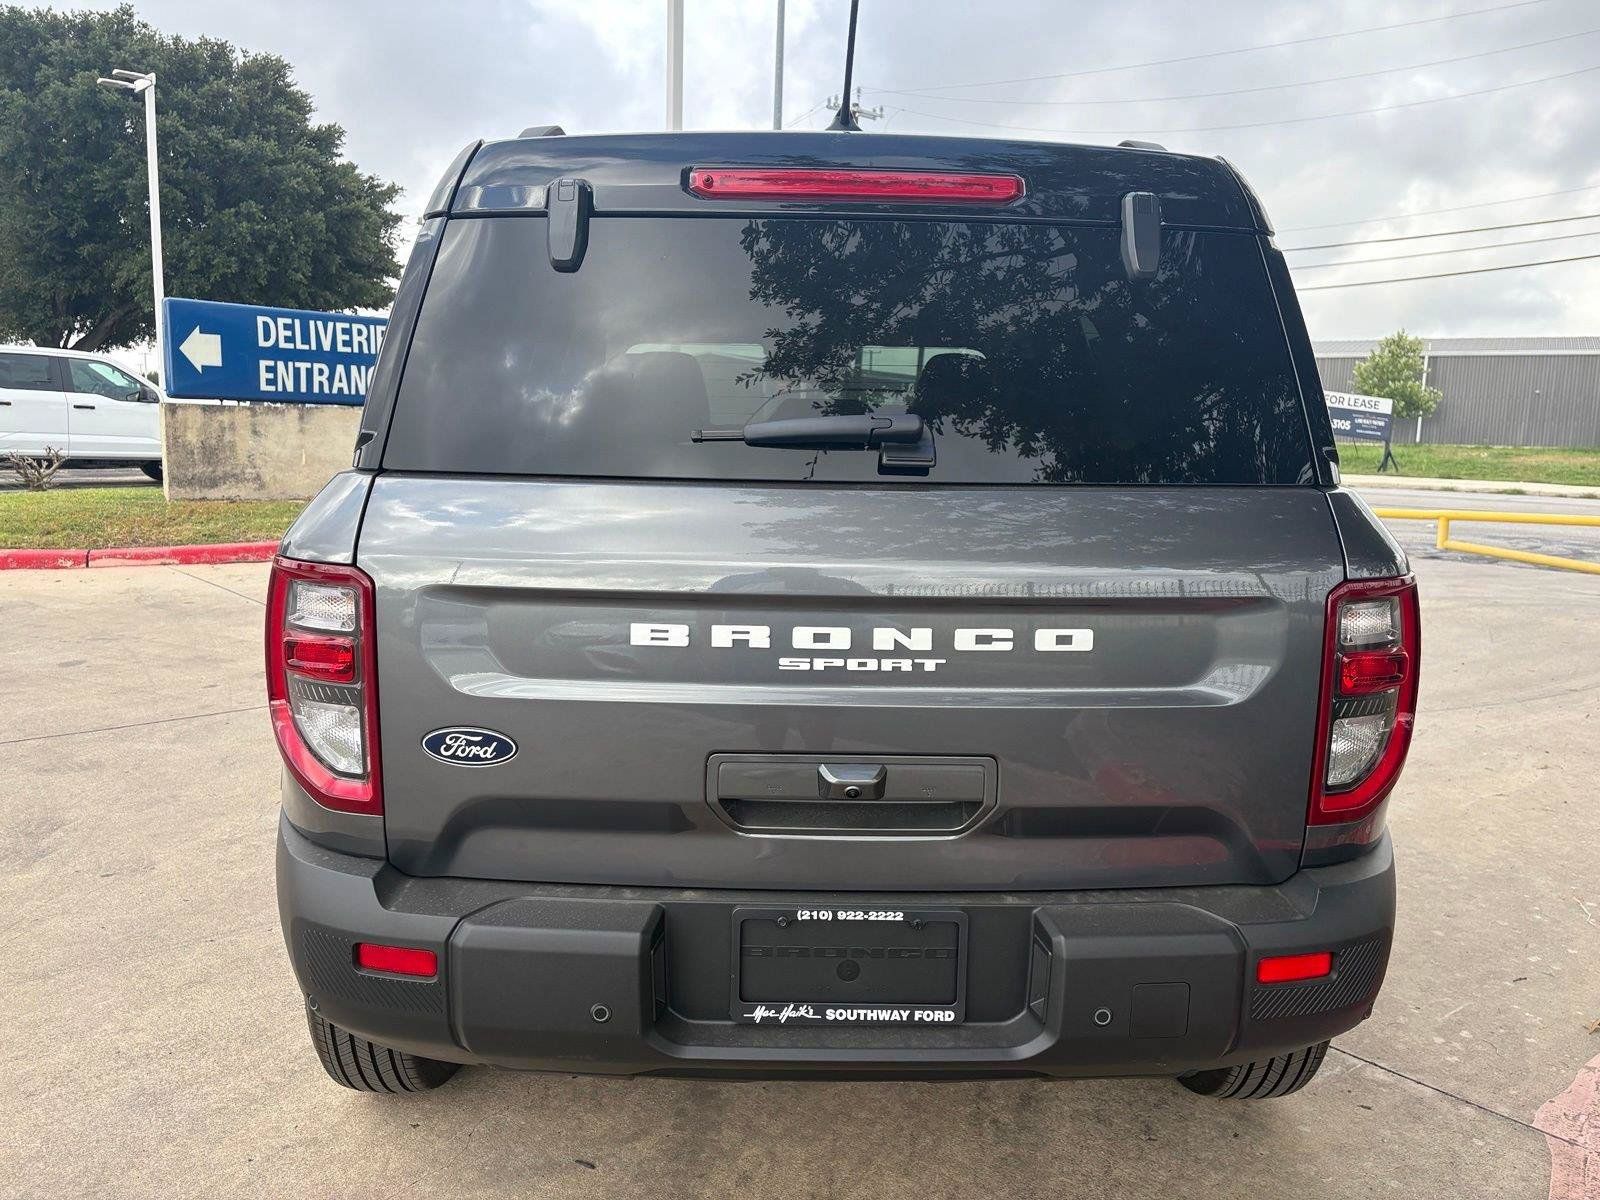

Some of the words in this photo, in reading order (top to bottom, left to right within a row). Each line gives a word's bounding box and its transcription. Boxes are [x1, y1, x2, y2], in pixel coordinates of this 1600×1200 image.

[1348, 396, 1380, 410] LEASE
[629, 622, 1094, 651] BRONCO
[778, 657, 947, 672] SPORT
[440, 733, 498, 759] Ford
[796, 910, 833, 921] (210)
[837, 911, 904, 921] 922-2222
[825, 1008, 910, 1021] SOUTHWAY
[914, 1010, 955, 1022] FORD
